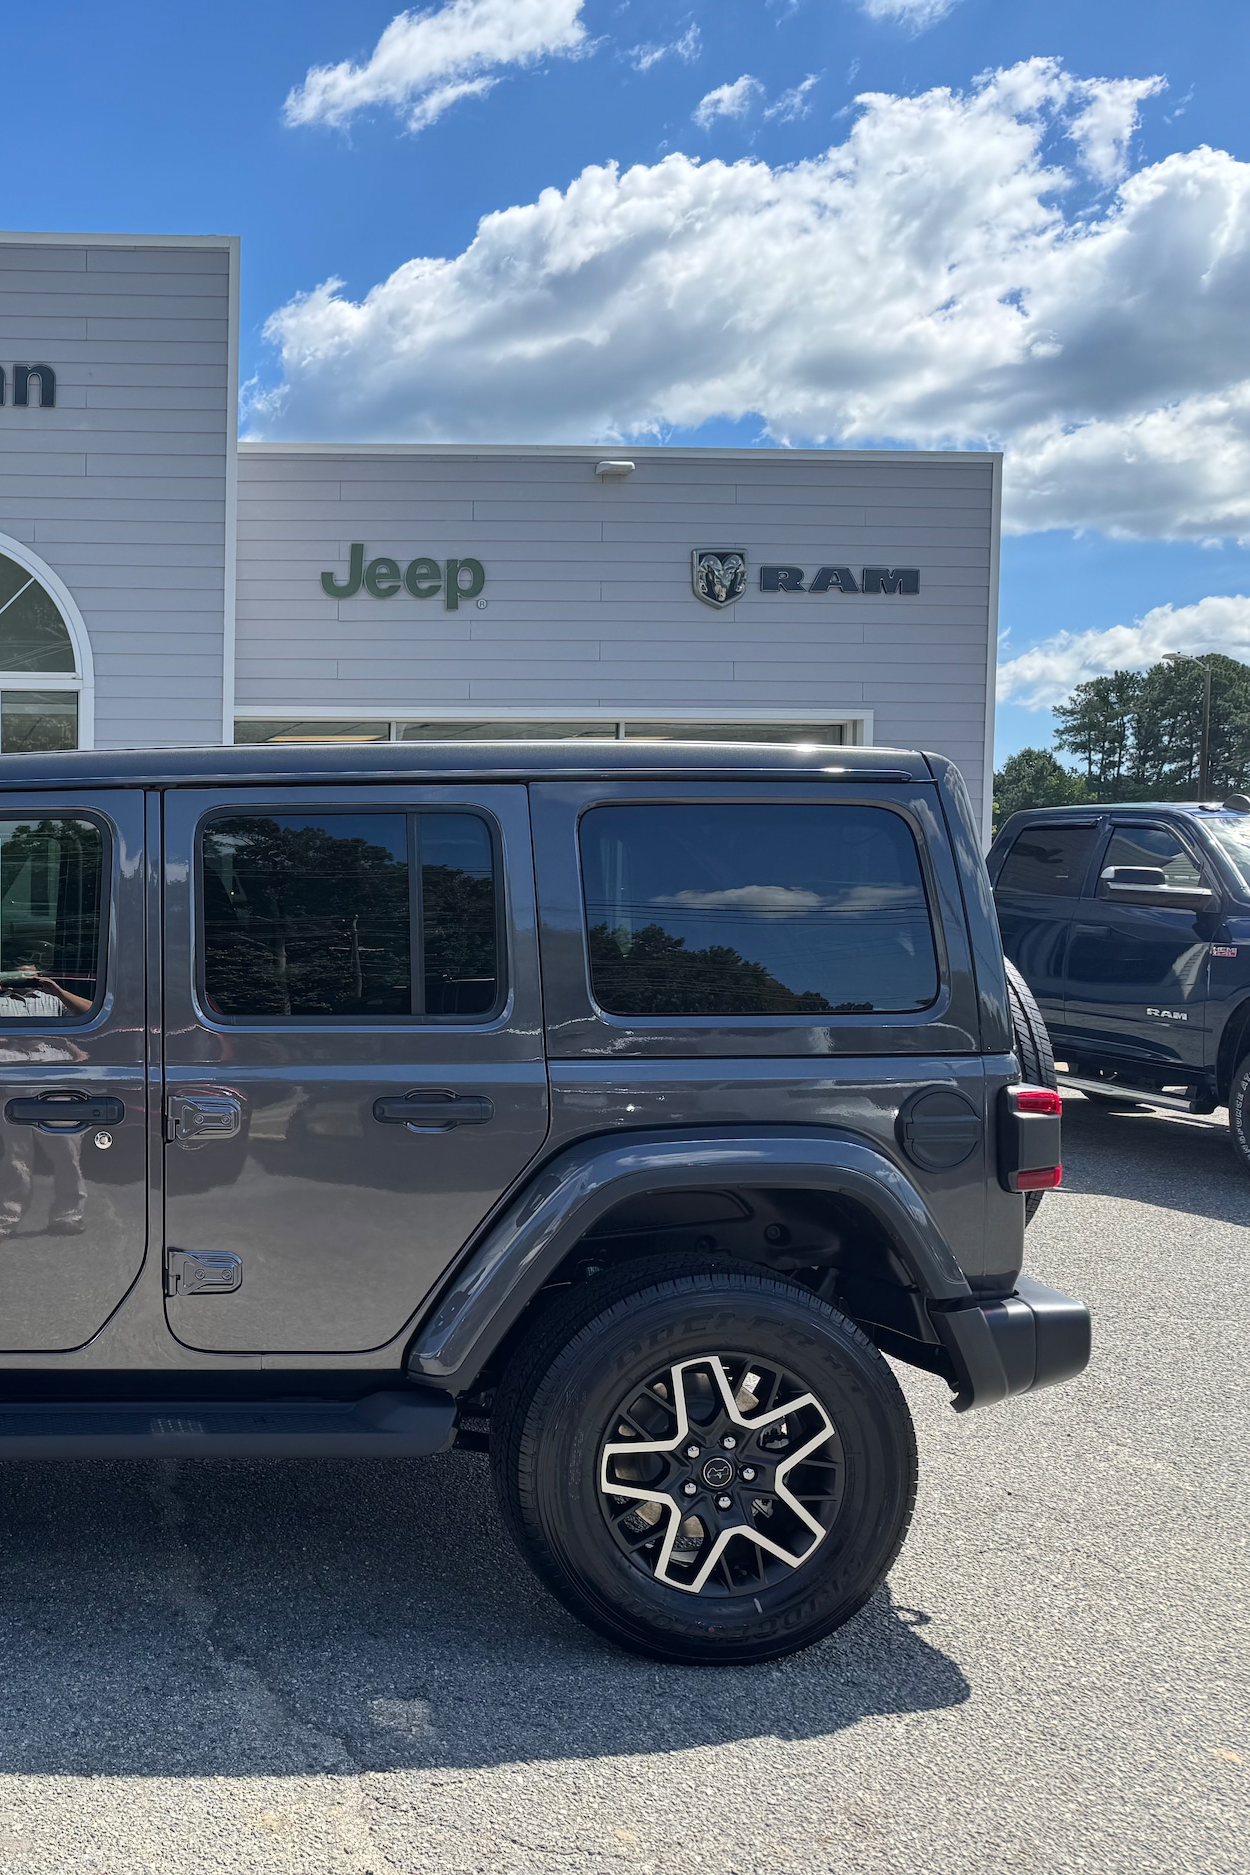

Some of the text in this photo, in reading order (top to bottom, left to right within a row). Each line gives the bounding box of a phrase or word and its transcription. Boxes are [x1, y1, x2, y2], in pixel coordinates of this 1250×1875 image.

[321, 543, 485, 611] Jeep
[760, 566, 920, 595] RAM
[1146, 1008, 1188, 1021] RAM
